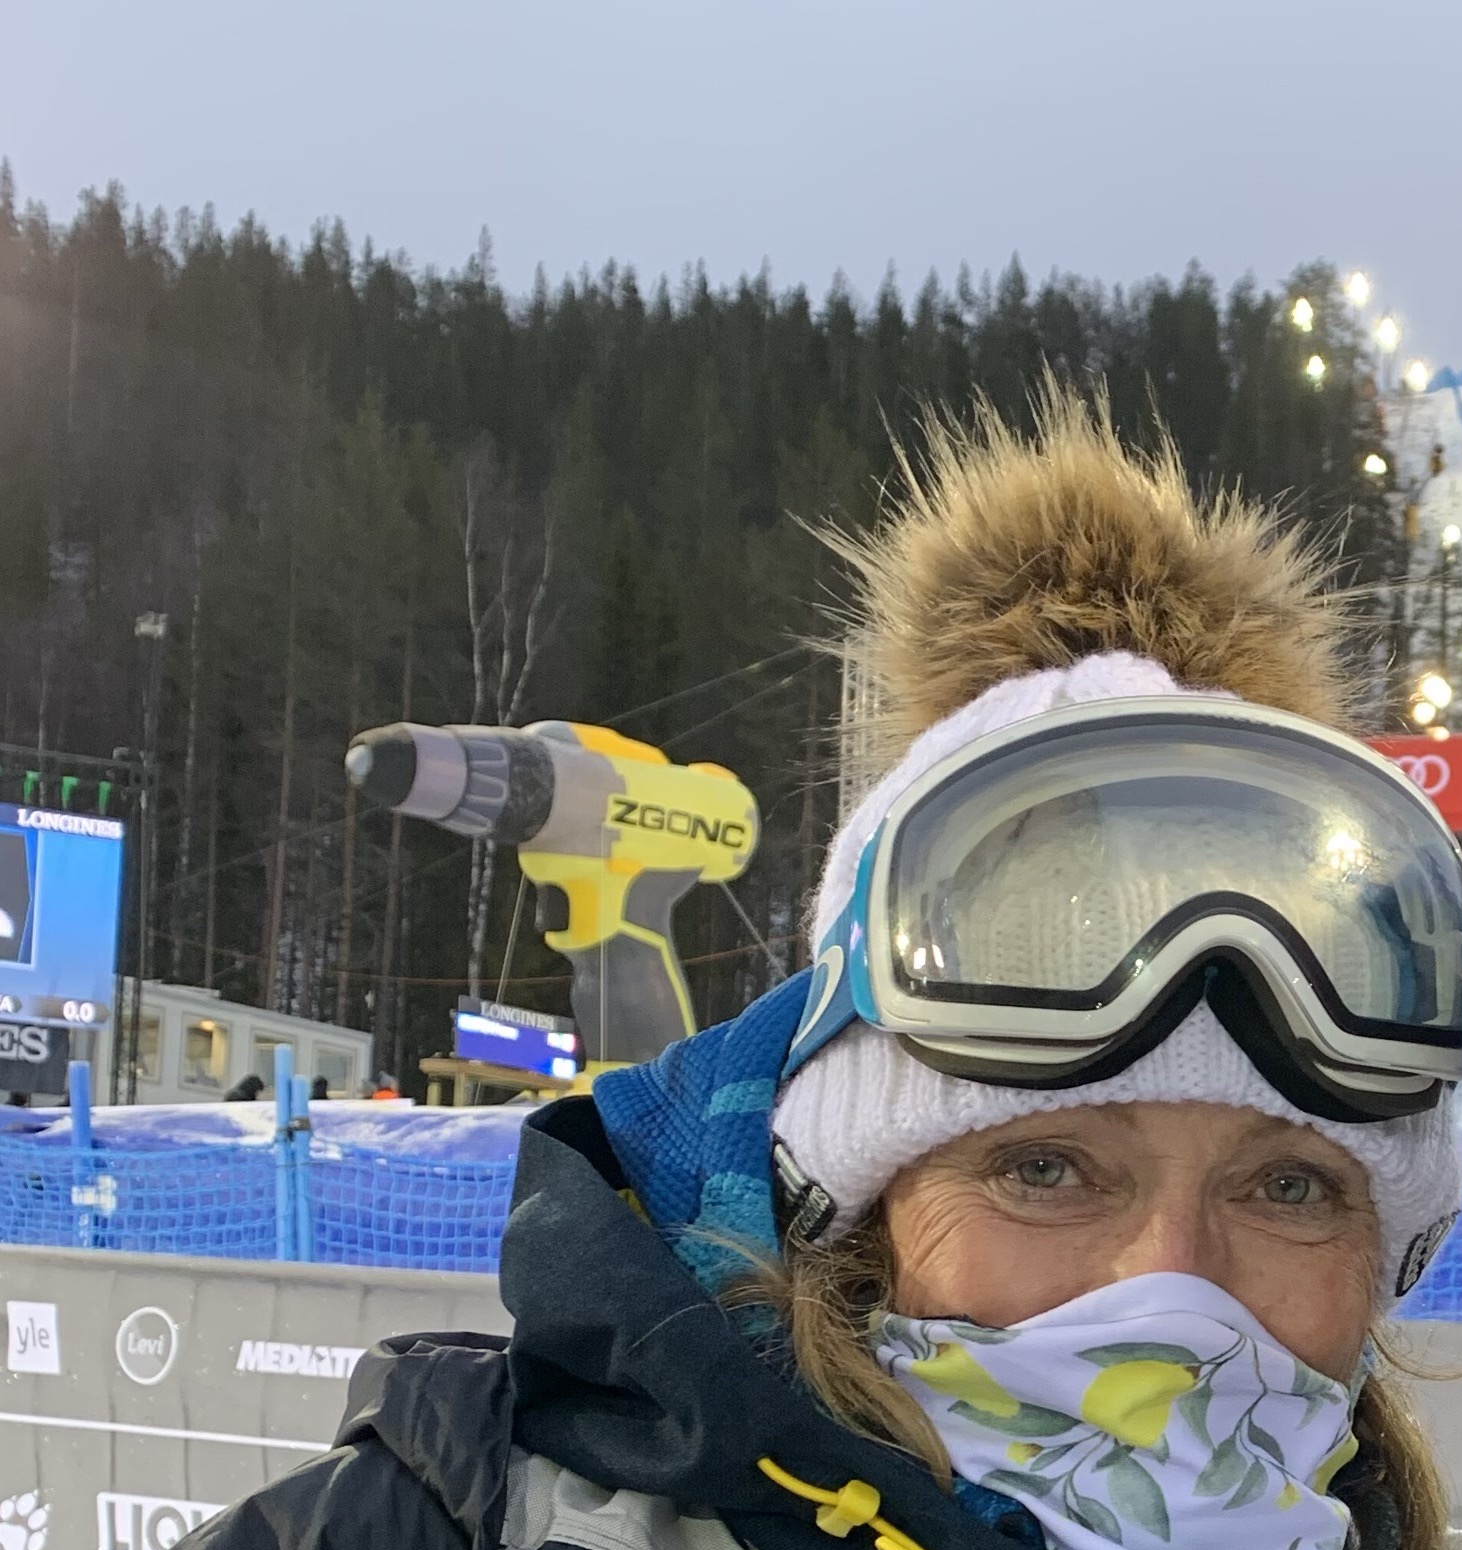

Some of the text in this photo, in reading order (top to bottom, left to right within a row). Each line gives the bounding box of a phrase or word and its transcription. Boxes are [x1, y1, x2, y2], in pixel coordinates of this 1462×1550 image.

[17, 808, 123, 841] LONGINES
[611, 798, 746, 849] ZGONC
[480, 1001, 555, 1031] LONGINES
[16, 1317, 50, 1355] yle
[127, 1332, 165, 1356] Levi
